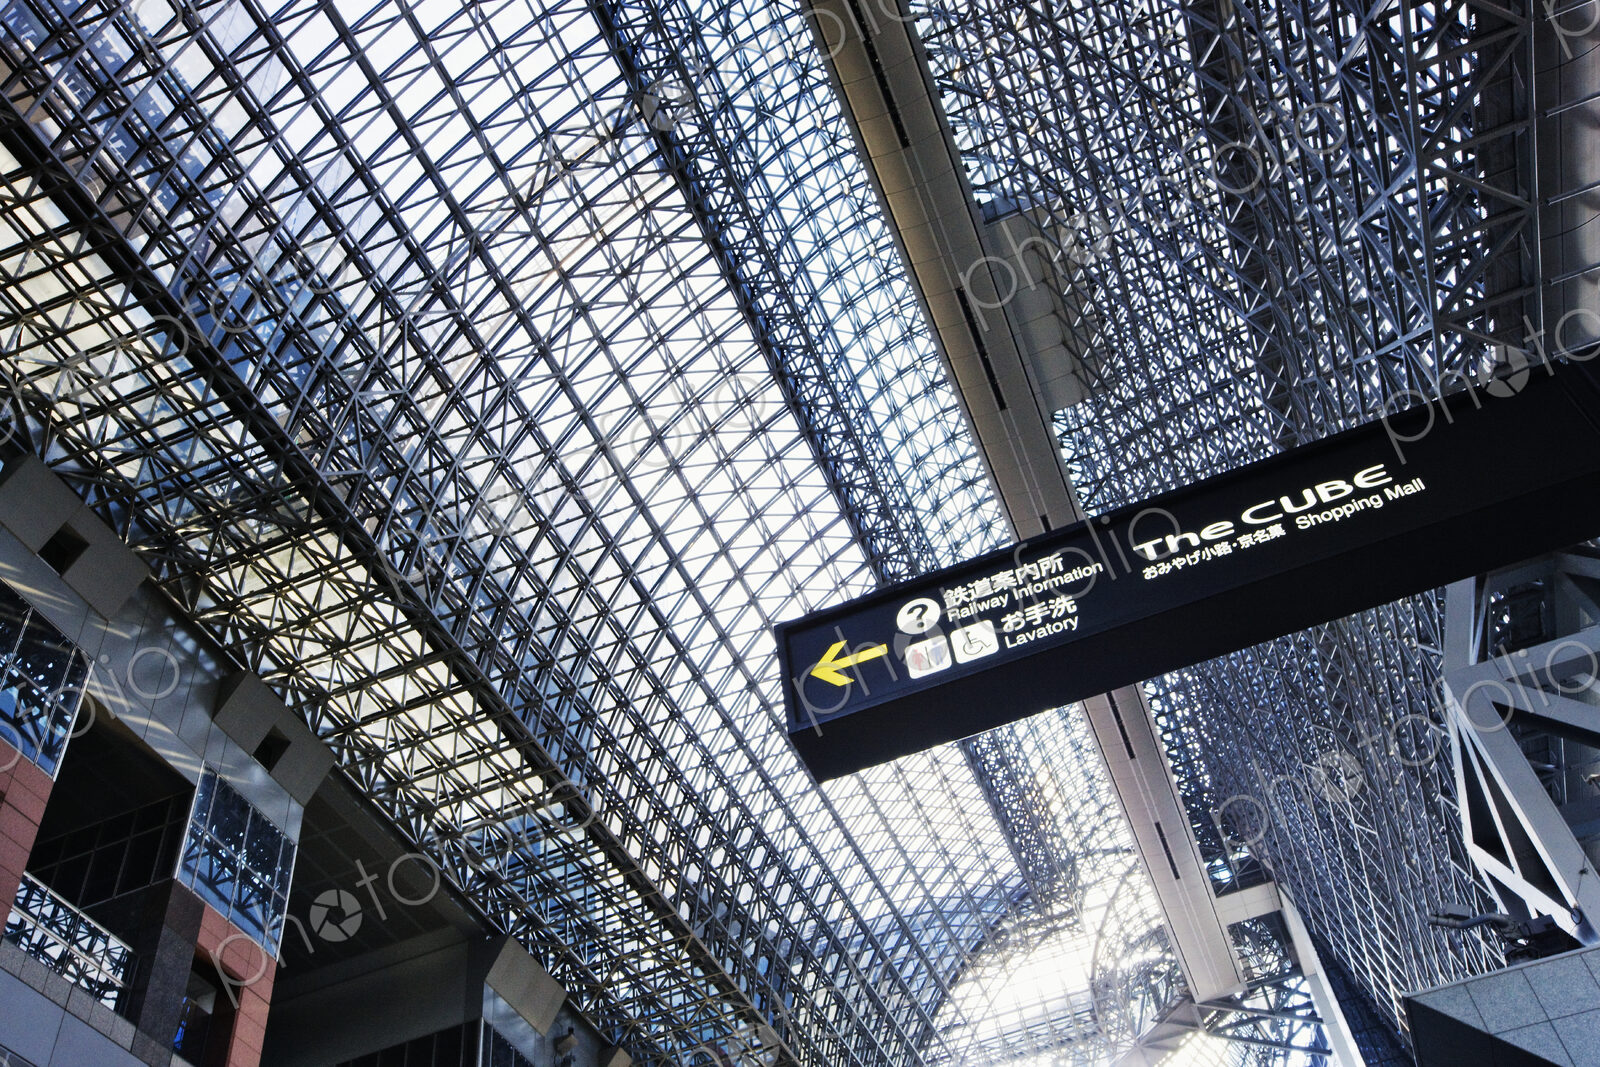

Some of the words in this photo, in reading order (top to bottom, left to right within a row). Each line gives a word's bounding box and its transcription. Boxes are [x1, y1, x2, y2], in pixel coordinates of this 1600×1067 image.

[1133, 520, 1235, 561] The
[1241, 463, 1393, 525] CUBE
[1295, 493, 1384, 530] Shopping
[1385, 477, 1426, 502] Mall
[943, 552, 1063, 608] 鉄道案内所
[946, 593, 1008, 622] Railway
[1013, 562, 1104, 600] Information
[1001, 594, 1077, 632] お手洗
[1004, 615, 1078, 649] Lavatory
